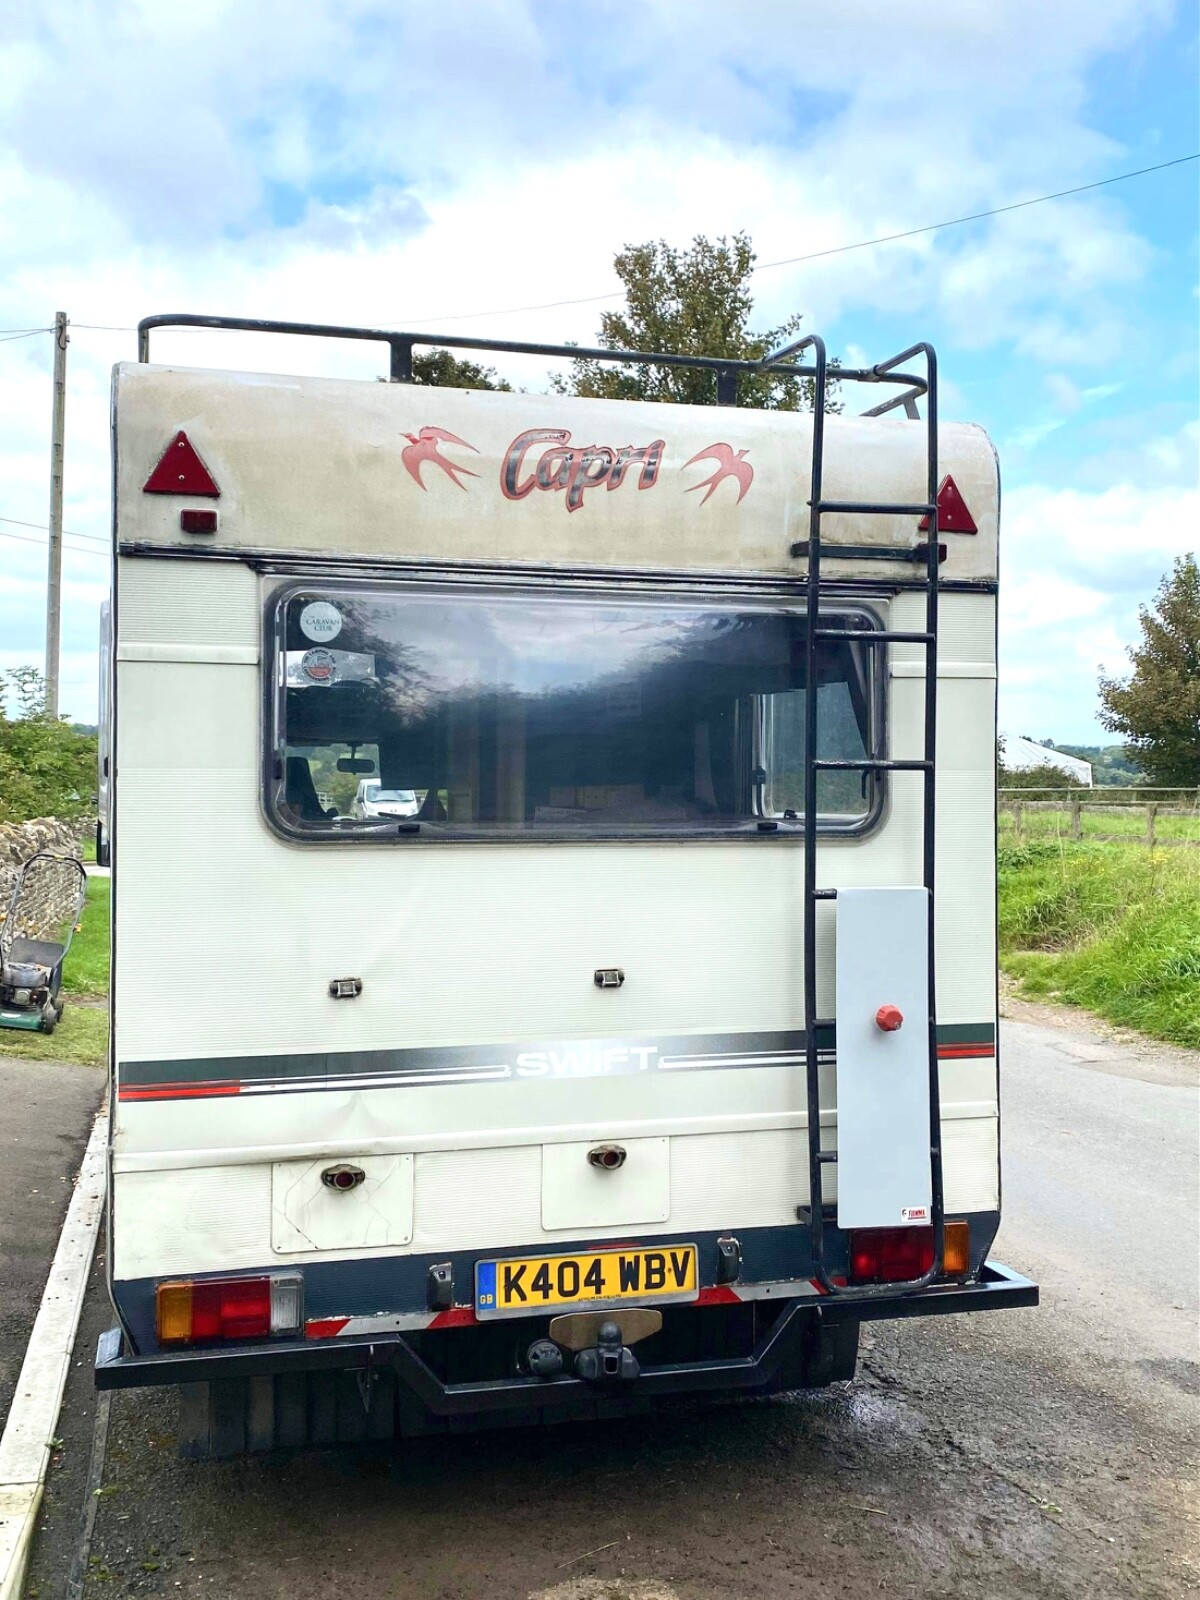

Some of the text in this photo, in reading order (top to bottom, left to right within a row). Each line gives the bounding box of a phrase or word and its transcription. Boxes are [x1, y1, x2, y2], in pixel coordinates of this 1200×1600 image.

[500, 428, 666, 513] Capri
[516, 1046, 658, 1077] SWIFT
[504, 1251, 691, 1303] K404 WBV
[480, 1294, 493, 1305] GB
